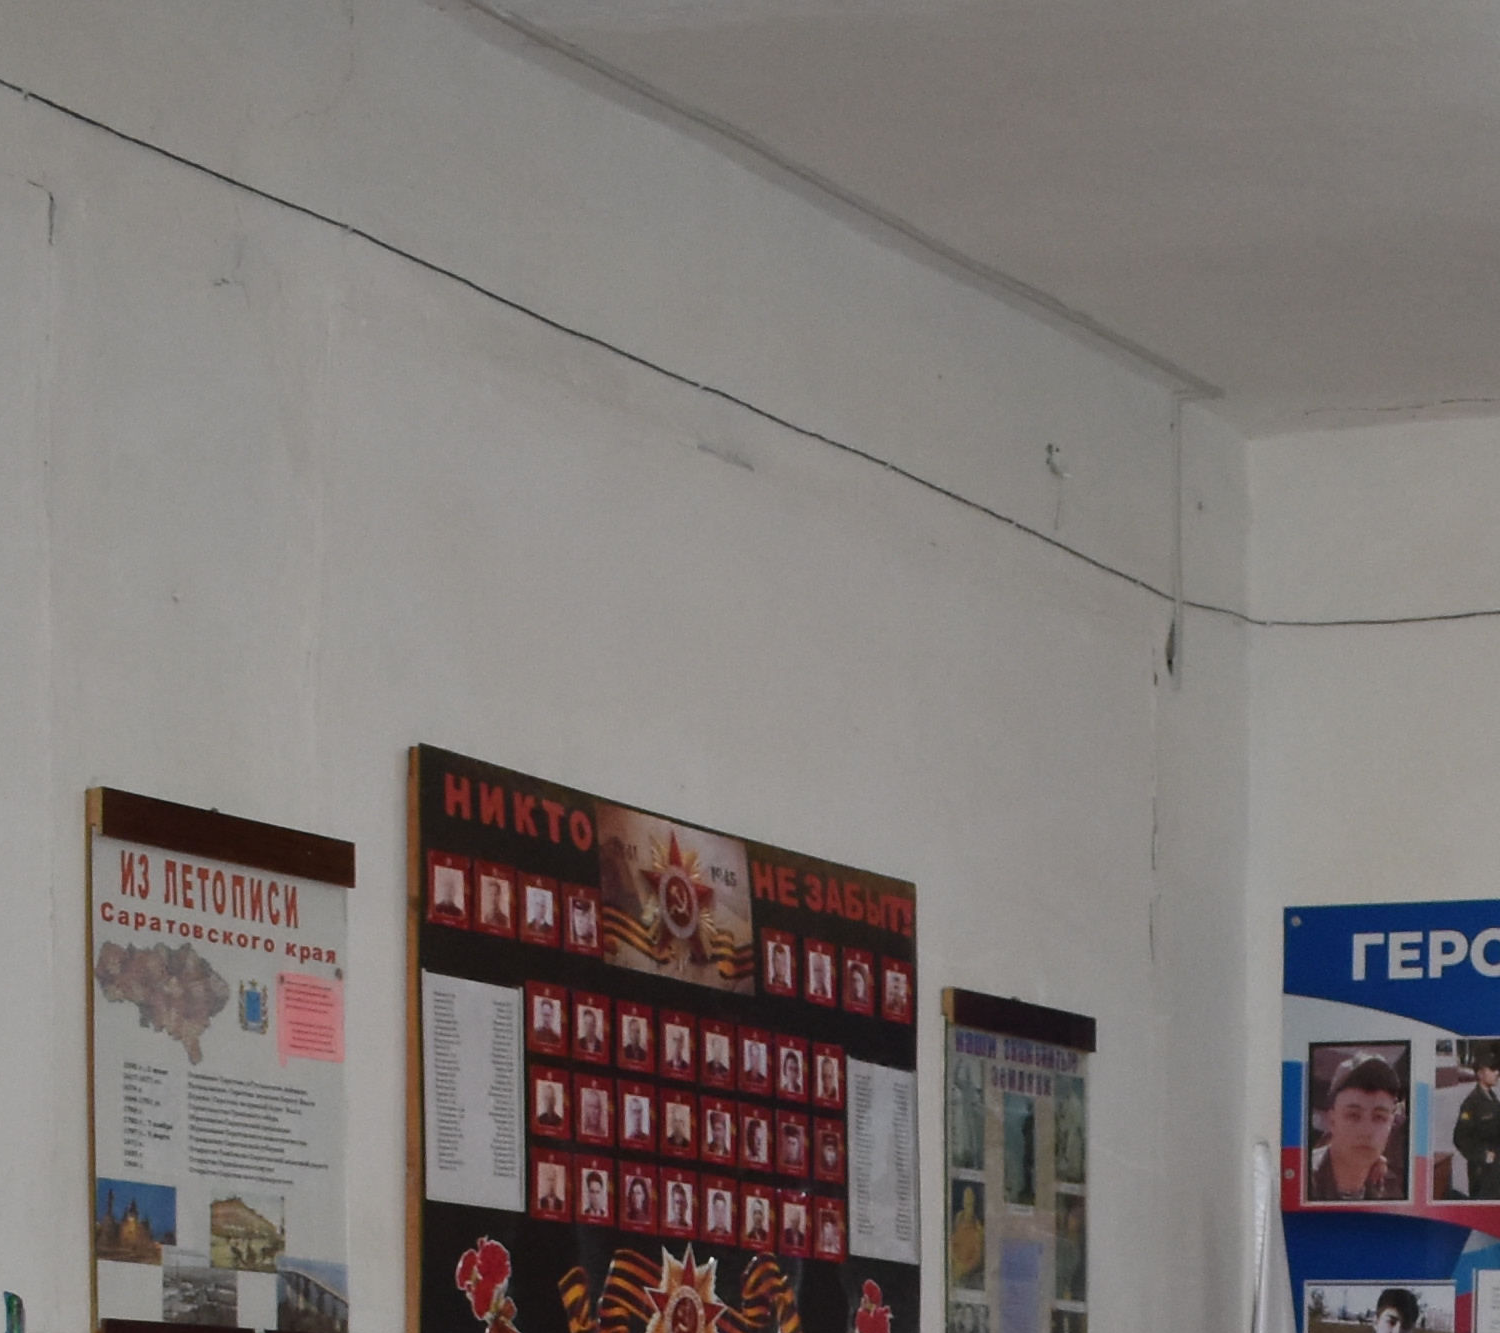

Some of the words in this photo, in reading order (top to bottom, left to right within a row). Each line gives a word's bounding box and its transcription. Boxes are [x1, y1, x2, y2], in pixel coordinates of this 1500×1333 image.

[444, 772, 593, 851] НИКТО
[753, 860, 799, 907] НЕ
[120, 850, 150, 900] ИЗ
[163, 859, 299, 929] ЛЕТОПИСИ
[100, 901, 276, 953] Саратовского
[285, 942, 337, 964] края
